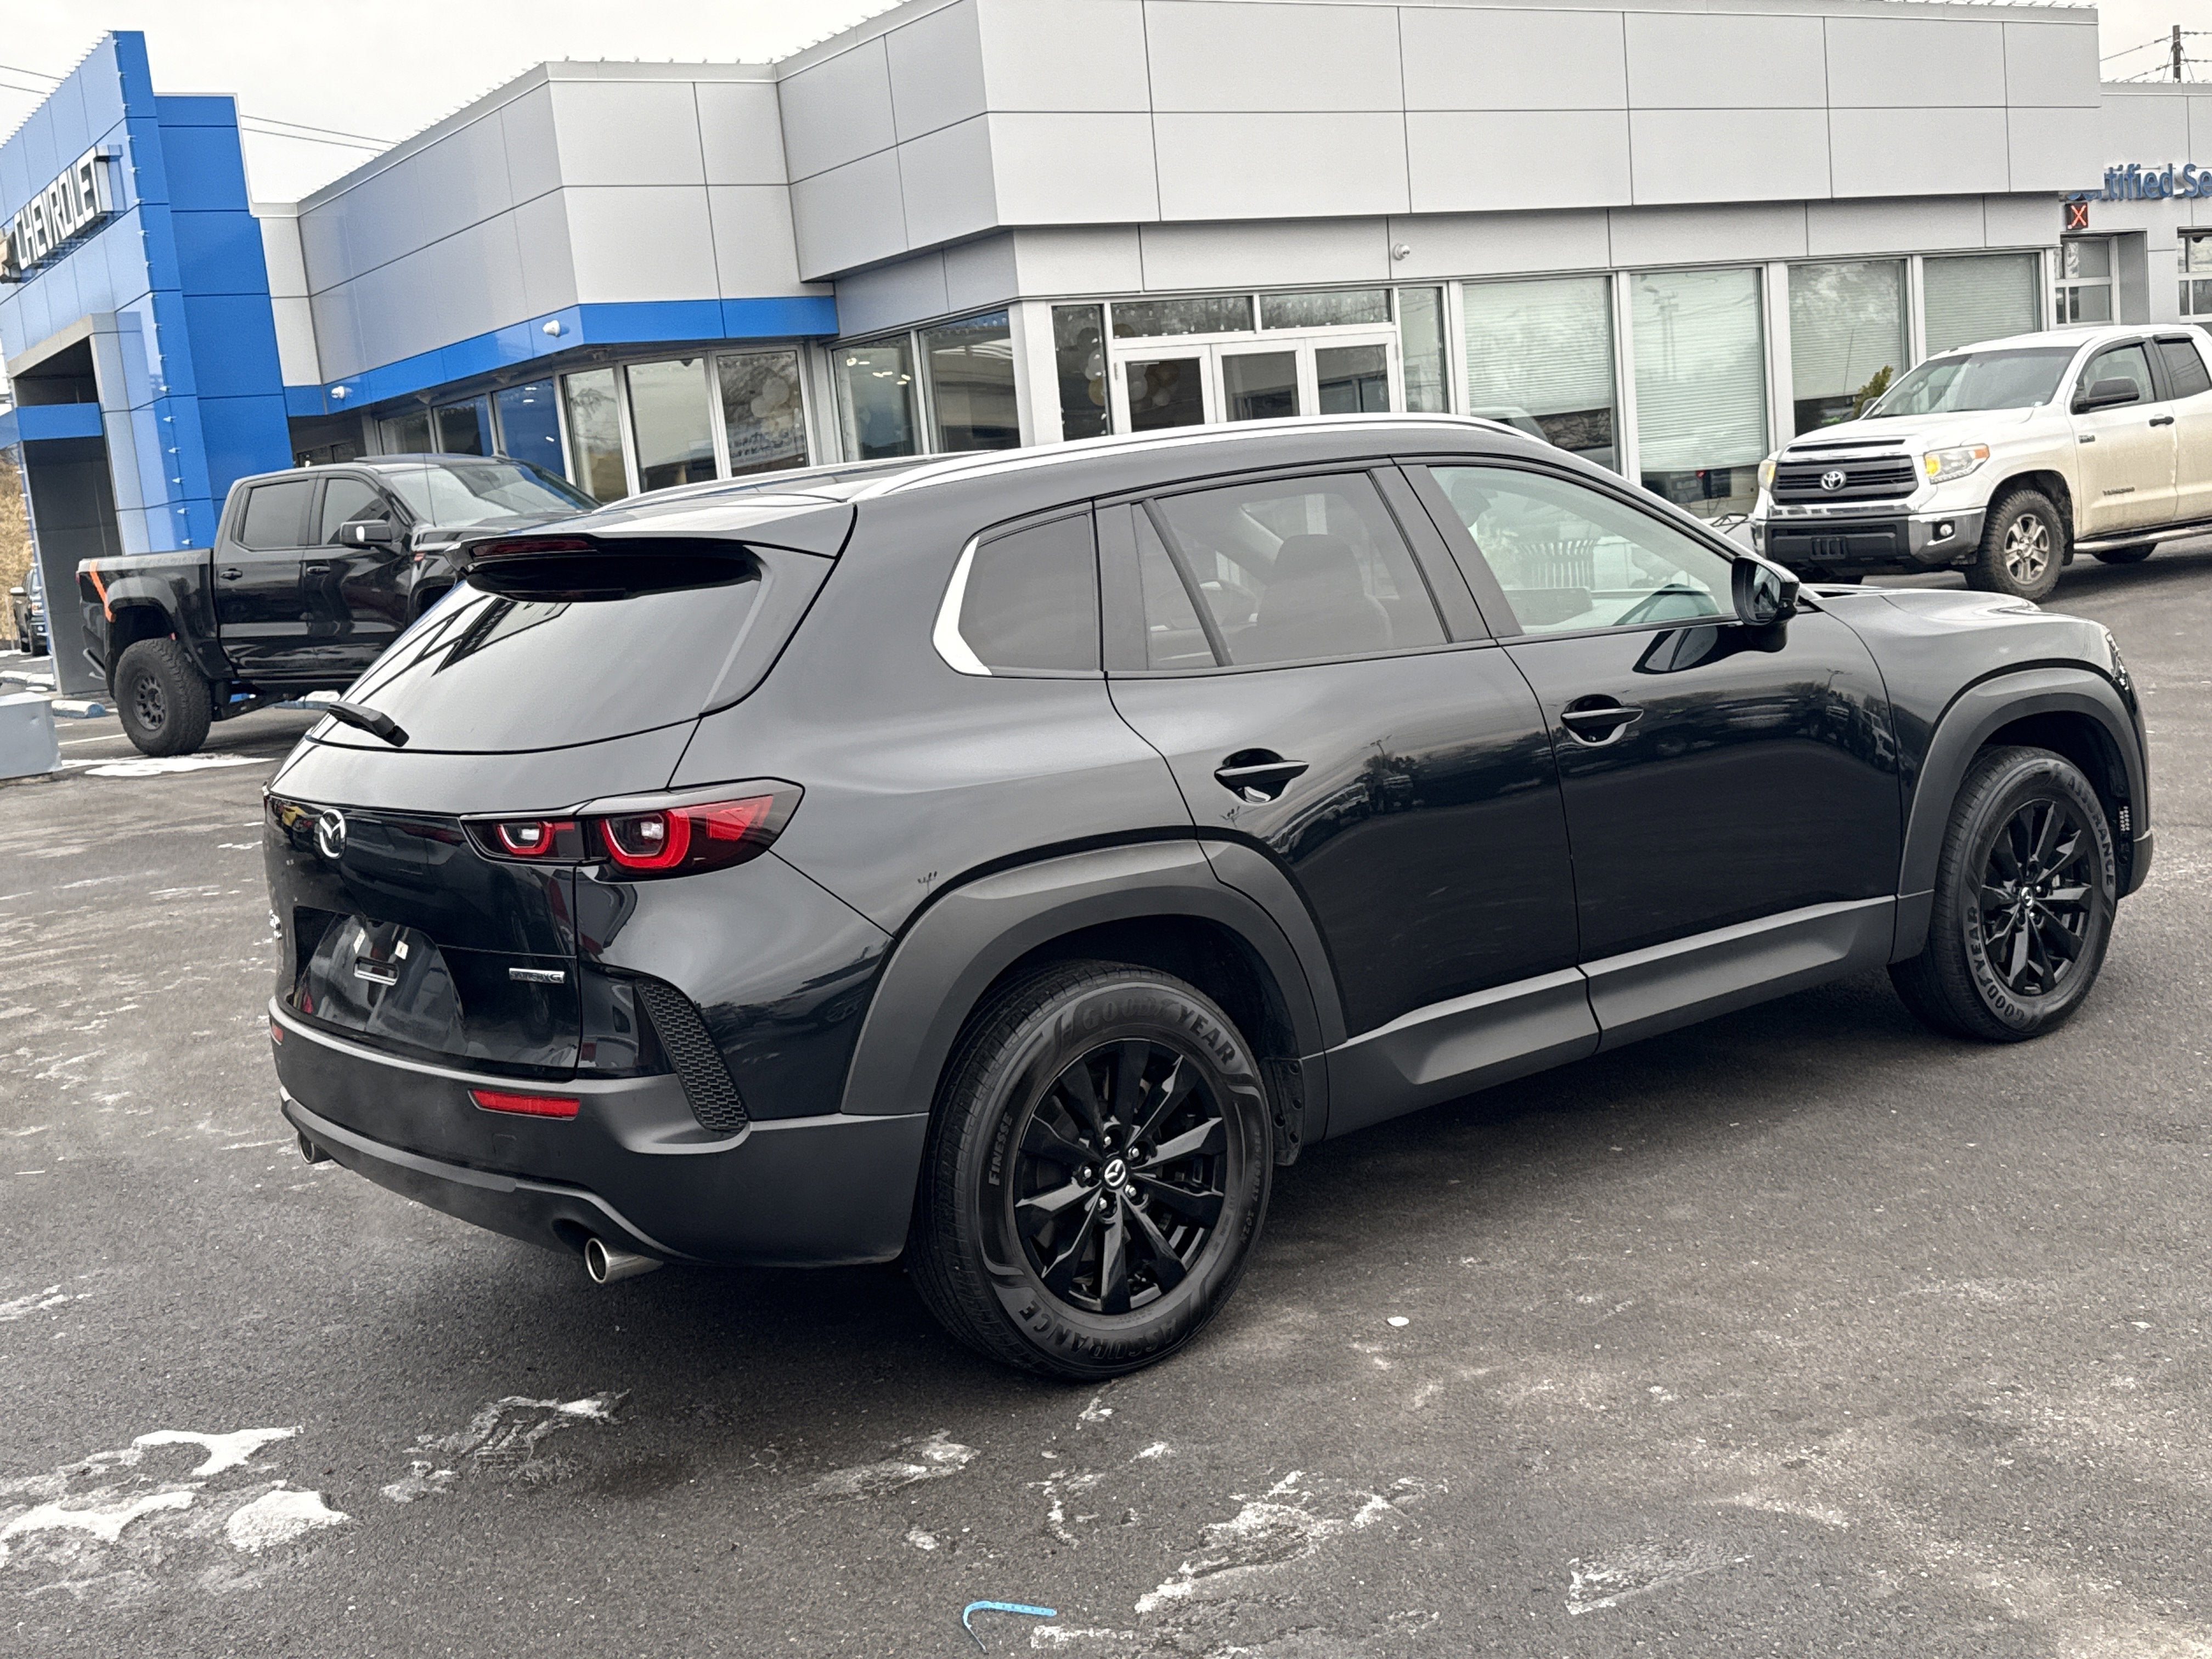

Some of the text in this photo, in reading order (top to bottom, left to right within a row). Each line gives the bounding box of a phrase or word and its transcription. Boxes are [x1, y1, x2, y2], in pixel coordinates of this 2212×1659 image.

[14, 146, 101, 270] CHEVROLET
[2066, 163, 2174, 200] tified
[1968, 906, 2024, 1022] GOODYEAR
[989, 1111, 1013, 1186] FINESSE
[1018, 1300, 1177, 1359] ASSURANCE
